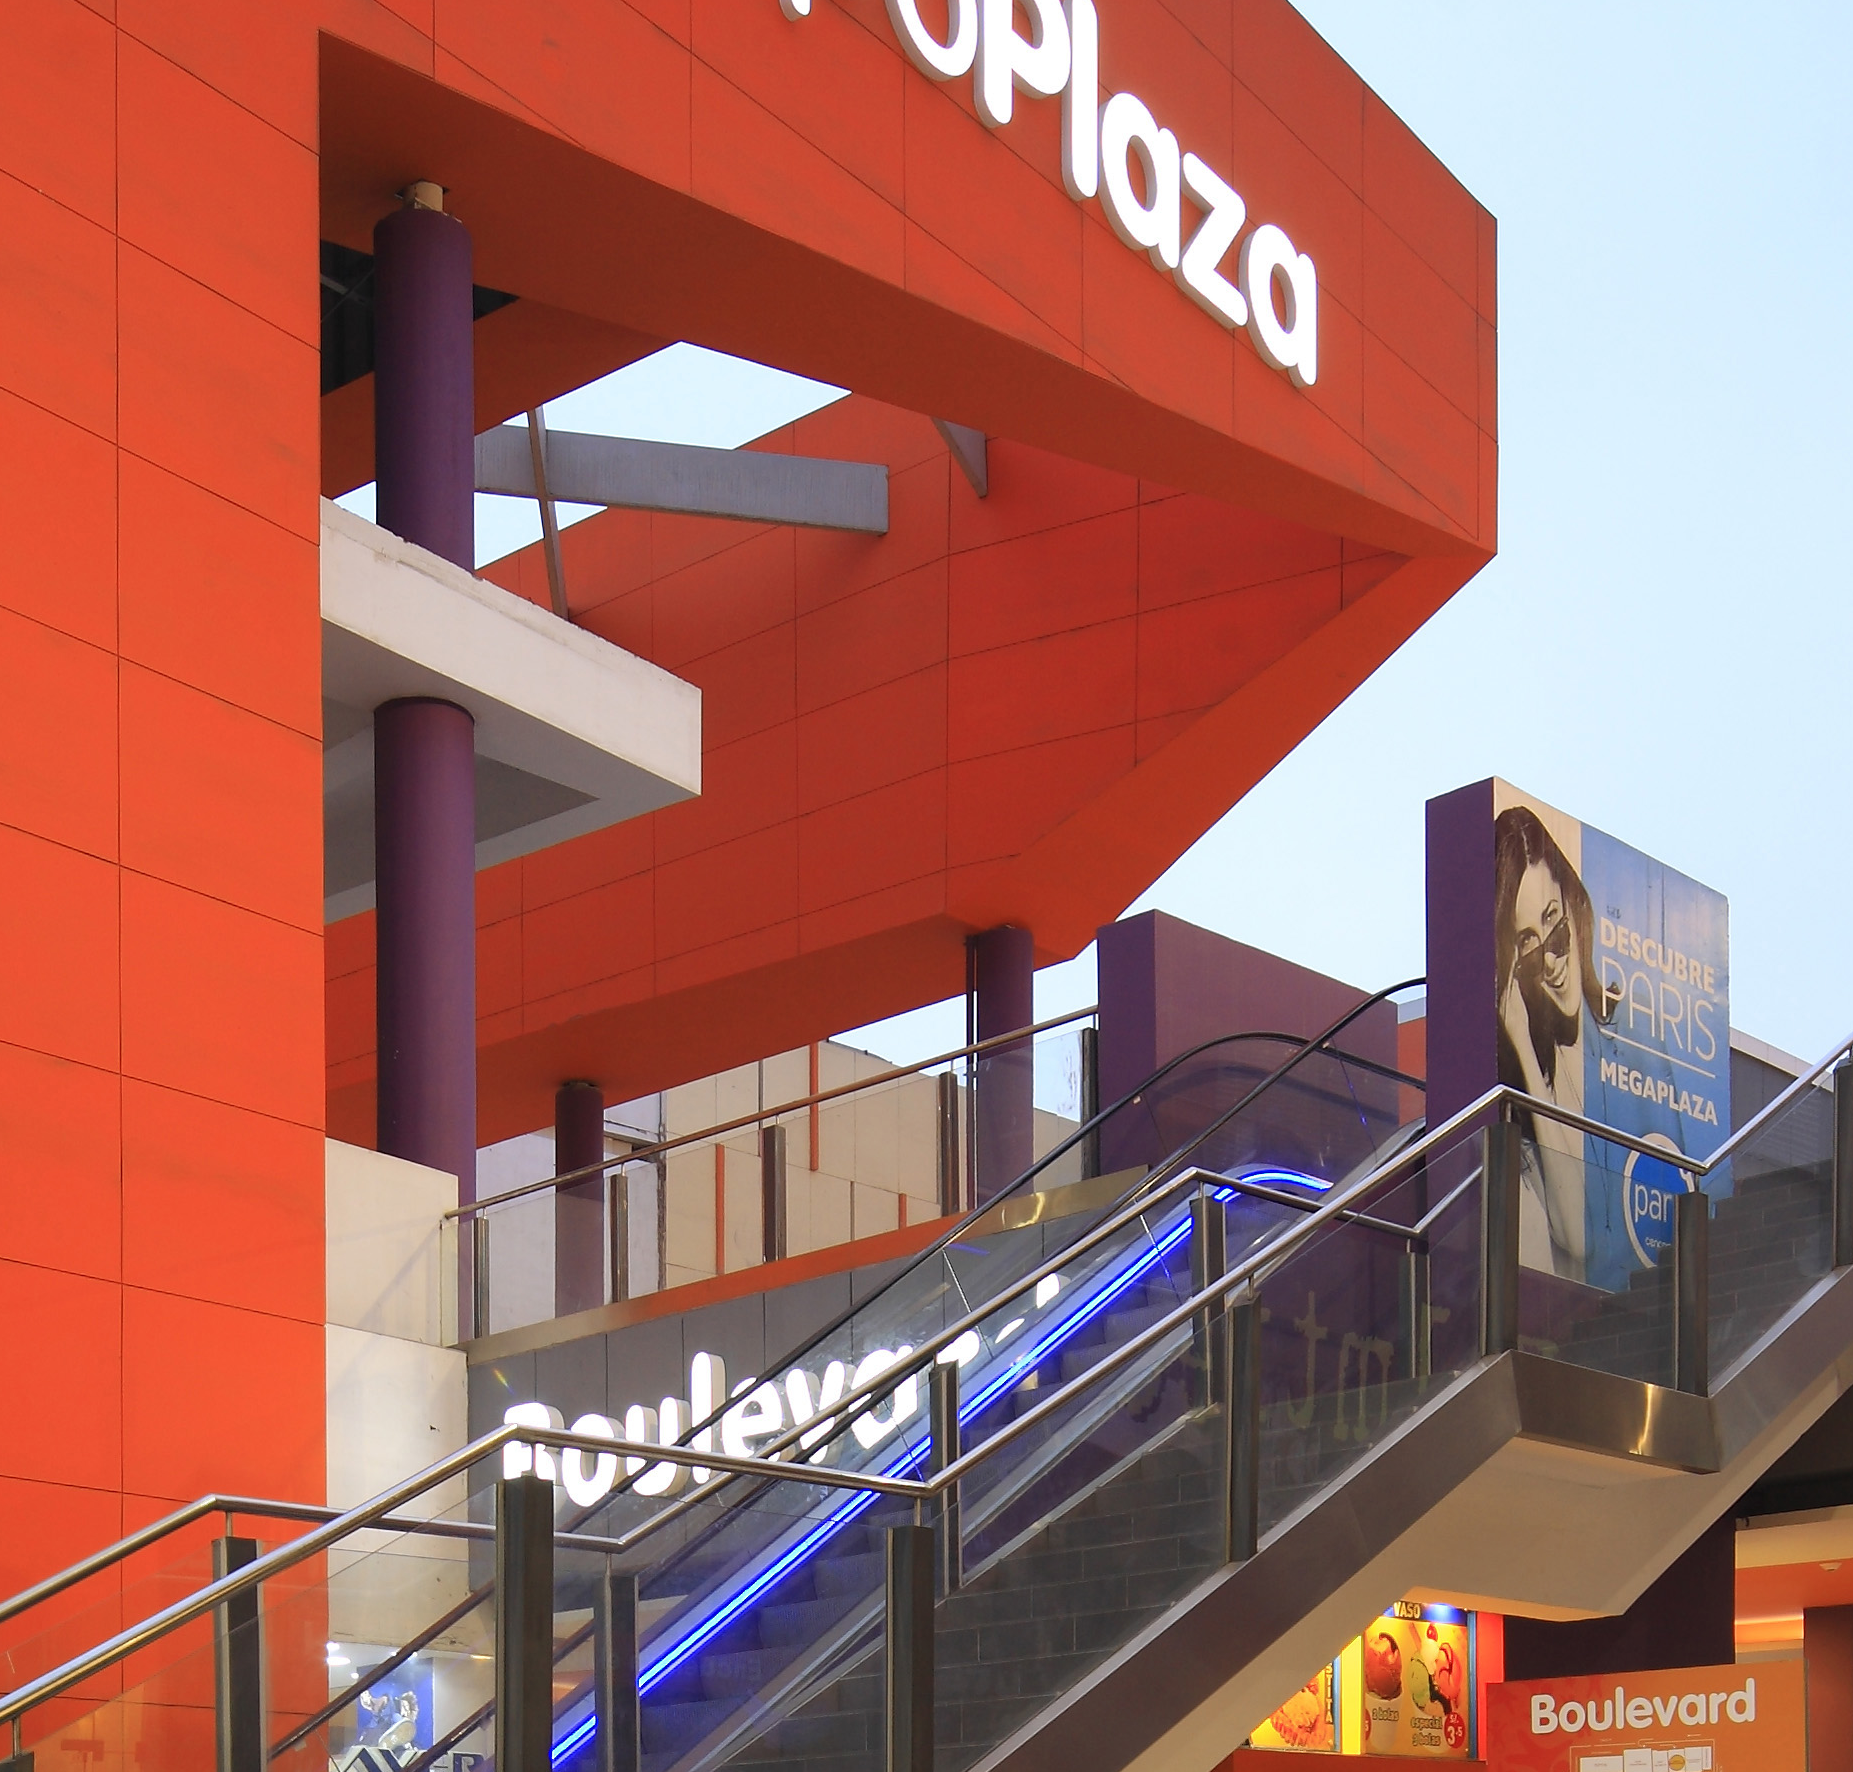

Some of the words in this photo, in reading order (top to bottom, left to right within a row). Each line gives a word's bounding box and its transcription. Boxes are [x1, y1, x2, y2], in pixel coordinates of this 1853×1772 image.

[1601, 916, 1715, 994] DESCUBRE
[1602, 956, 1716, 1061] PARIS
[1601, 1058, 1719, 1126] MEGAPLAZA
[1635, 1184, 1673, 1222] par
[1531, 1677, 1756, 1735] Boulevard
